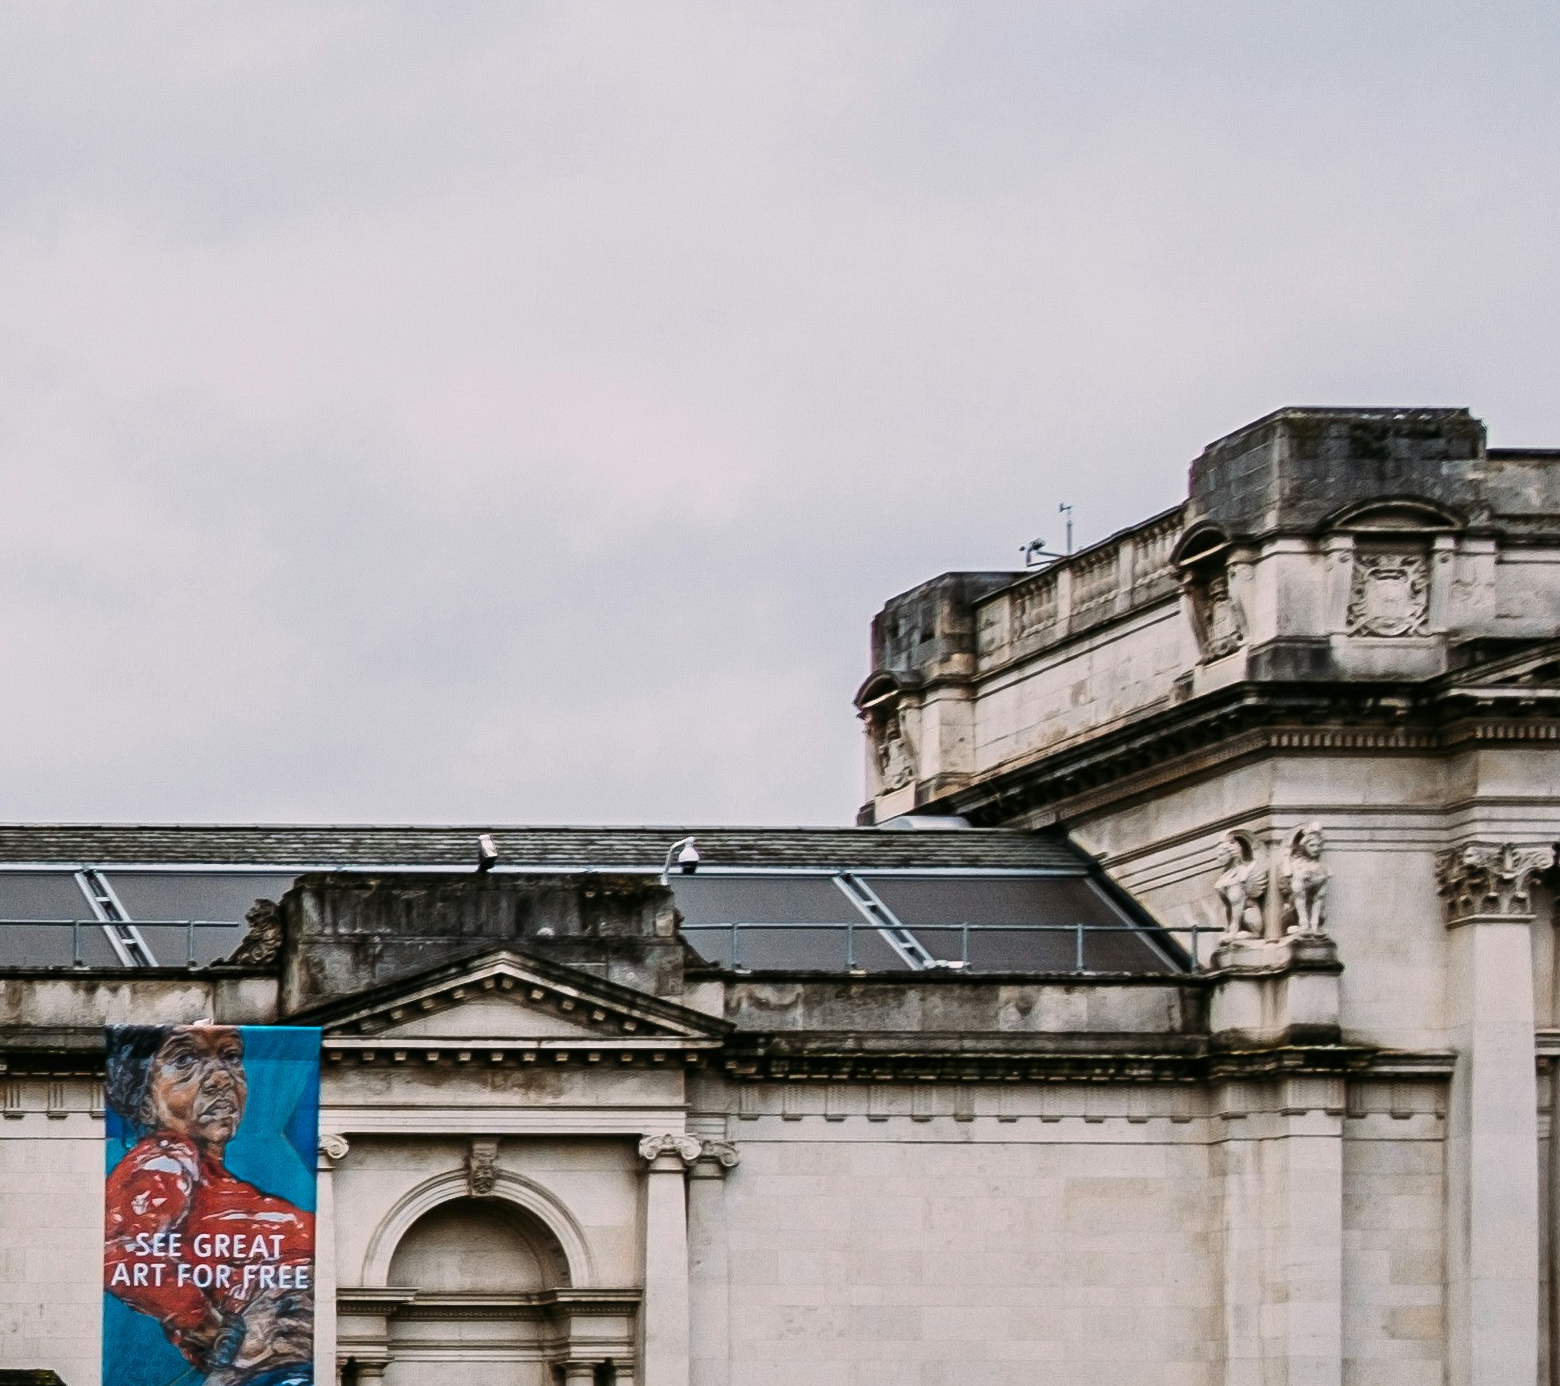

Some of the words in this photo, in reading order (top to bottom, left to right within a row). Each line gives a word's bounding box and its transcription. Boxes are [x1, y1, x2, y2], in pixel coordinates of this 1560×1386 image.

[135, 1232, 182, 1257] SEE
[193, 1233, 286, 1259] GREAT
[110, 1263, 167, 1287] ART
[176, 1264, 230, 1289] FOR
[243, 1265, 310, 1289] FREE
